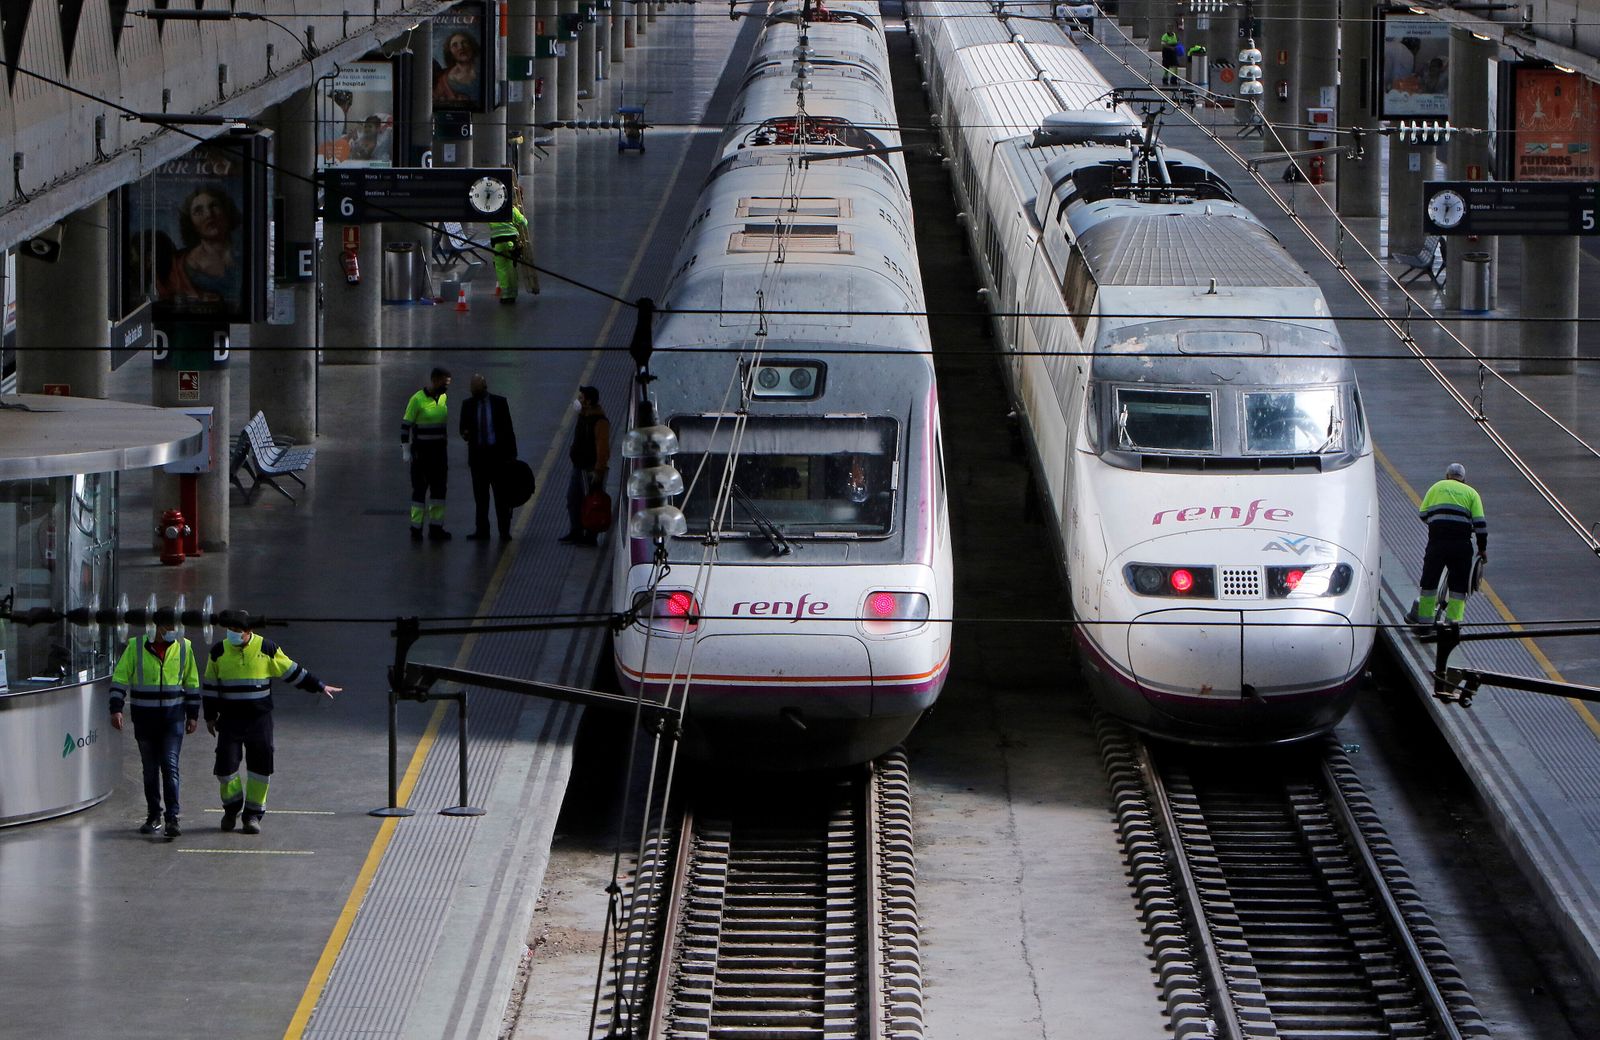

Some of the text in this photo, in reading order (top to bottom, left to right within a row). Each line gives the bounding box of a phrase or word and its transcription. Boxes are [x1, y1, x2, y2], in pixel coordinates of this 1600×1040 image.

[576, 21, 583, 31] 6
[1239, 27, 1245, 37] 5
[548, 39, 558, 54] K
[526, 59, 533, 76] J
[460, 124, 469, 137] 6
[421, 150, 433, 168] G
[1520, 155, 1572, 165] FUTUROS
[340, 196, 355, 217] 6
[1582, 209, 1595, 230] 5
[298, 249, 313, 277] E
[153, 329, 169, 361] D
[213, 330, 230, 362] D
[1151, 498, 1295, 527] renfe
[1261, 536, 1332, 559] AVE
[731, 592, 830, 623] renfe
